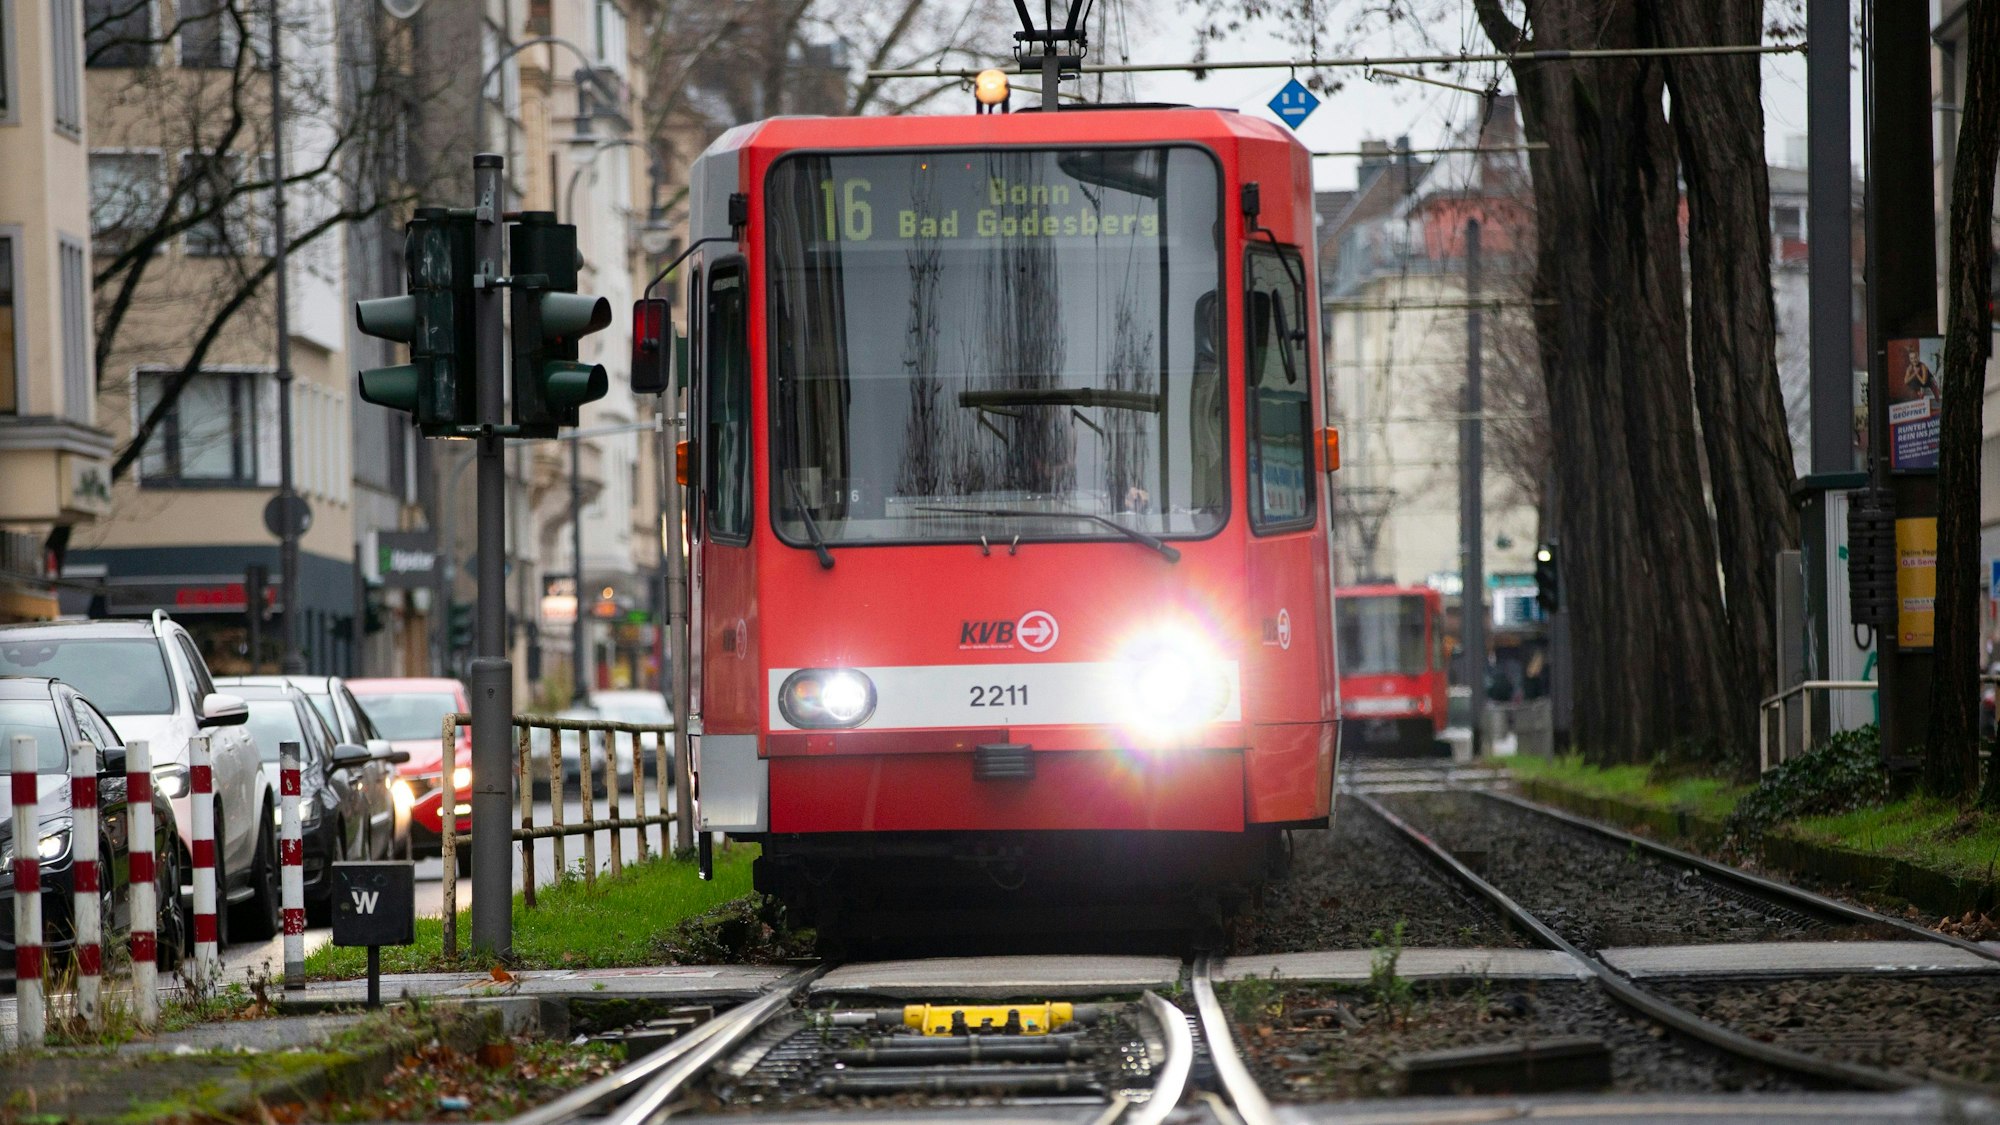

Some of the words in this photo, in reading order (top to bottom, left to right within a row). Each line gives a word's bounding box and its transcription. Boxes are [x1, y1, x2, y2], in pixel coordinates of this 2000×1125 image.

[989, 178, 1069, 205] Bonn
[821, 178, 873, 241] 16
[899, 210, 958, 237] Bad
[976, 208, 1160, 237] Godesberg
[1893, 407, 1927, 419] GEÖFFNET
[1897, 431, 1916, 442] REIN
[1916, 430, 1928, 439] INS
[1898, 422, 1927, 434] RUNTER
[960, 621, 1015, 644] KVB
[969, 684, 1028, 707] 2211
[351, 891, 380, 914] W
